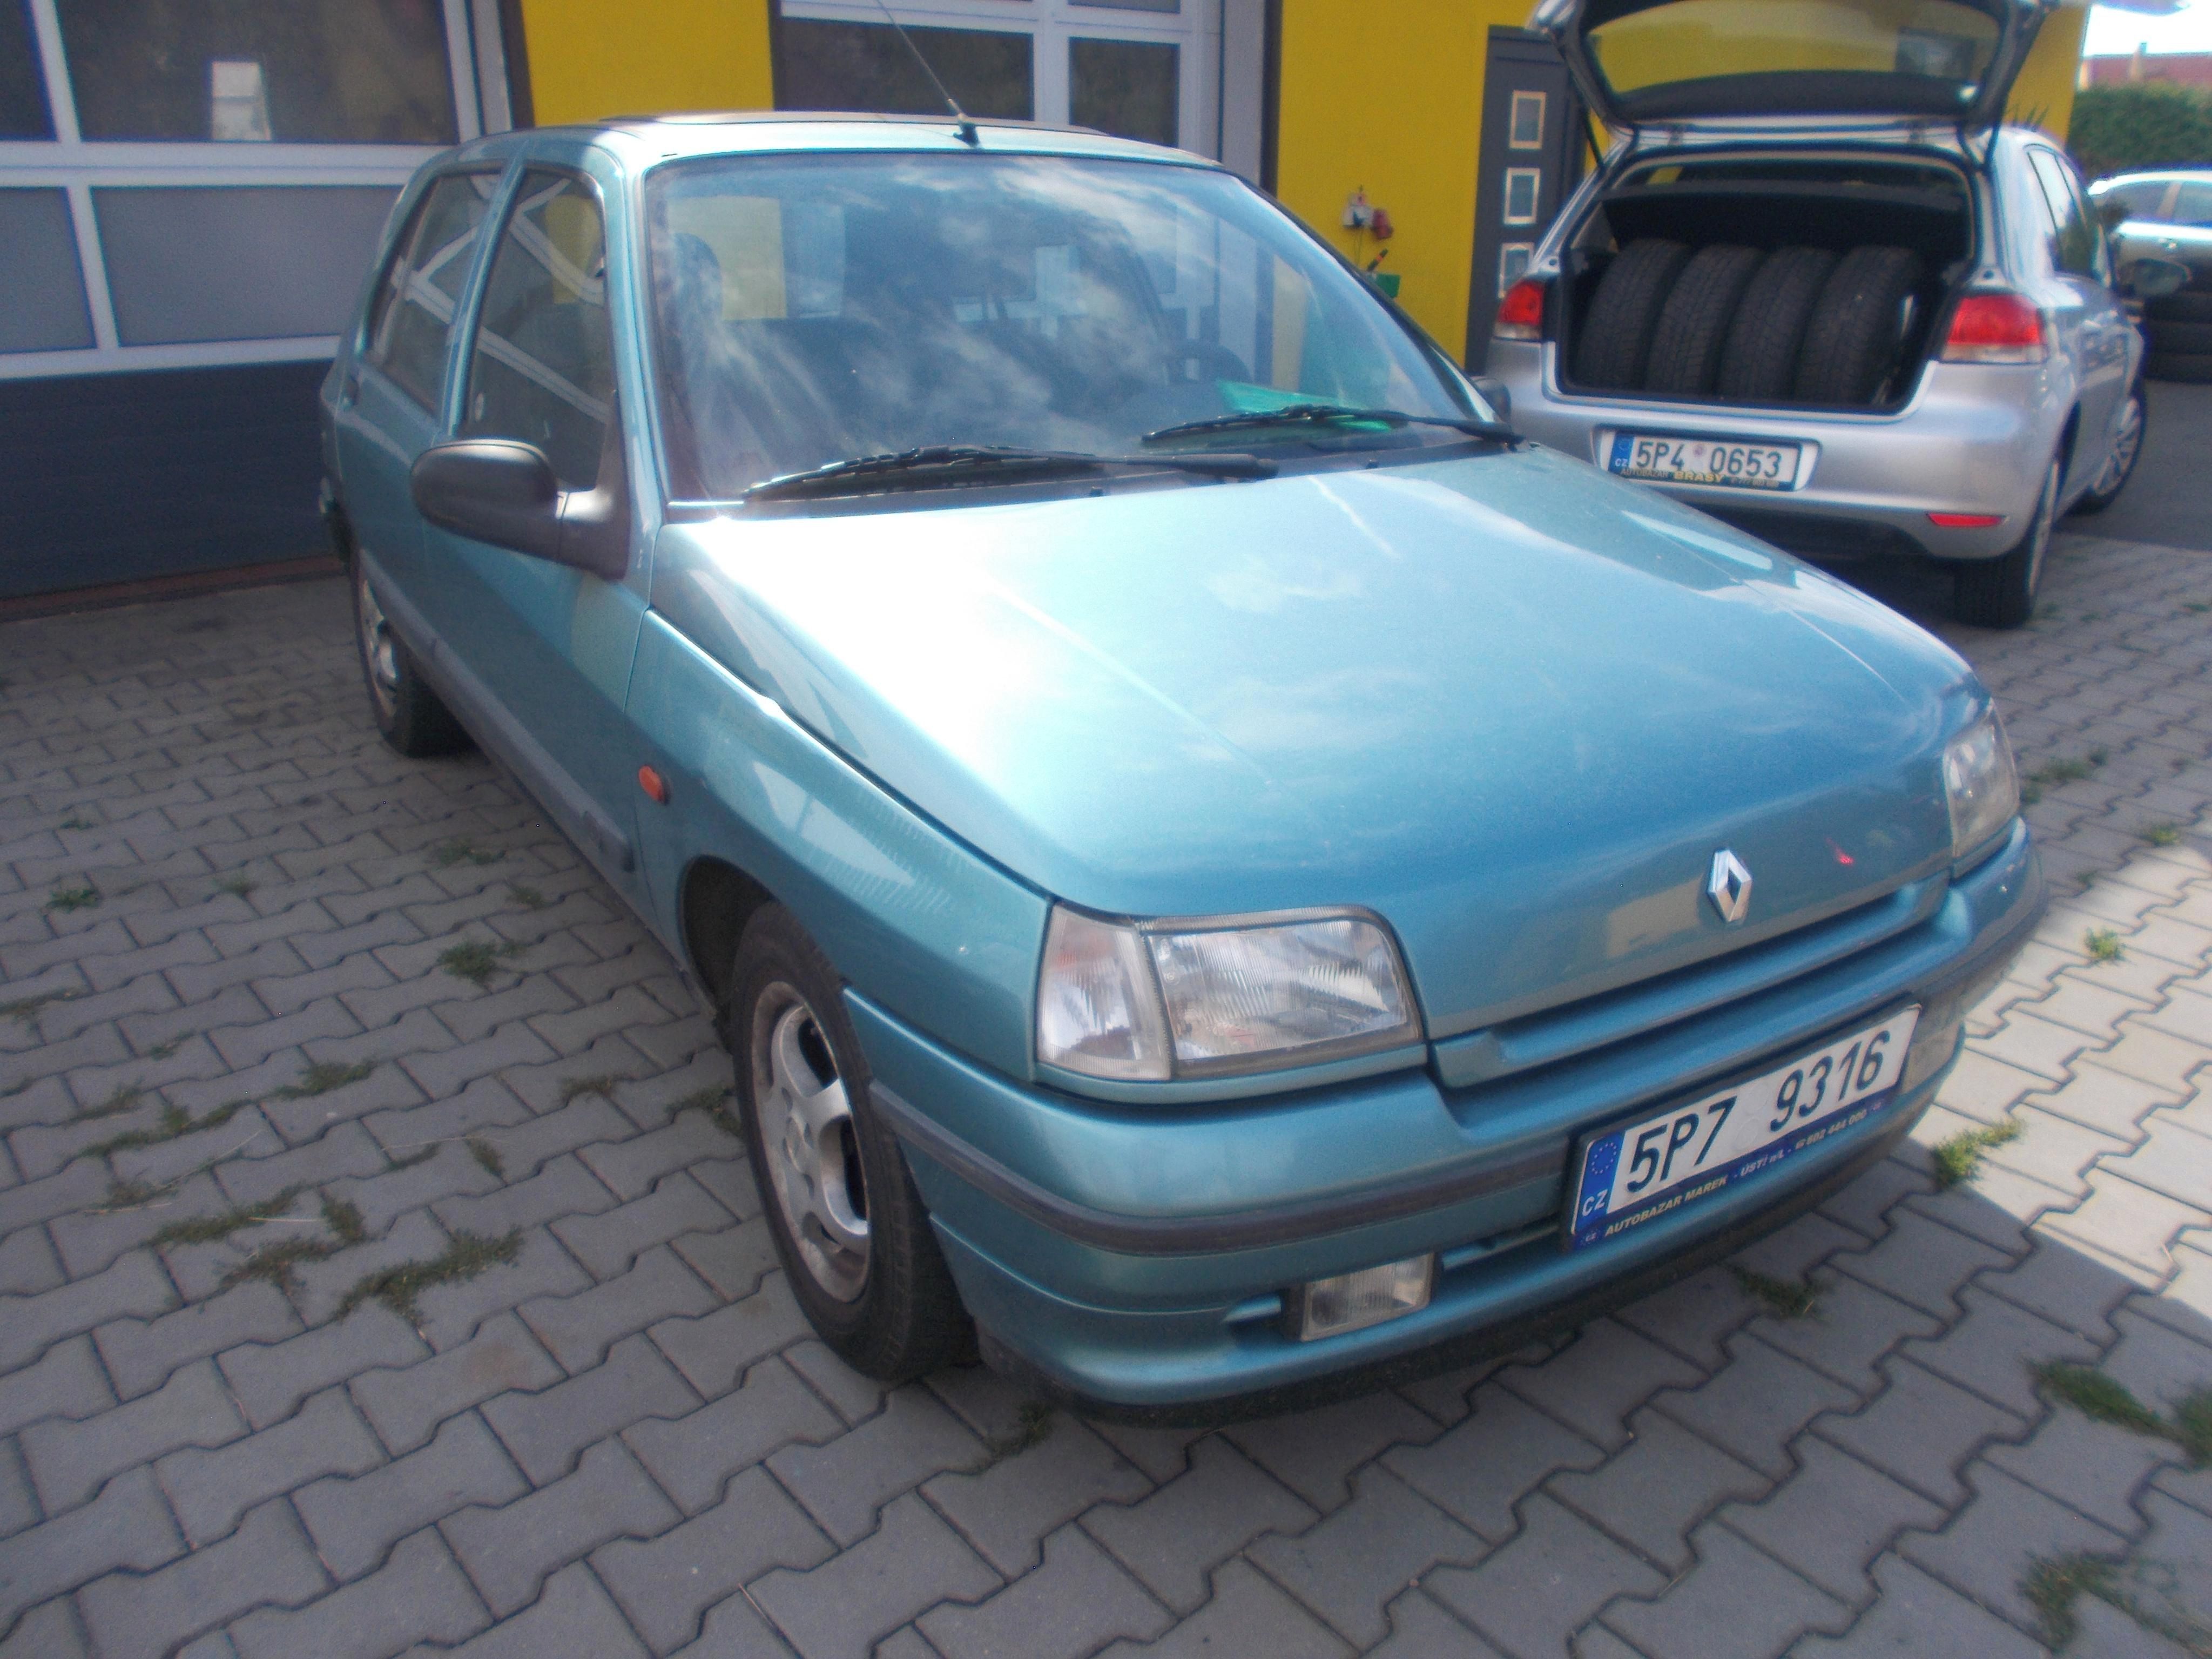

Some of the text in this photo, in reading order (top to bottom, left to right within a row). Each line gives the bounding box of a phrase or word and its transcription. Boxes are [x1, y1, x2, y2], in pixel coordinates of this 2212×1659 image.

[1615, 458, 1628, 467] CZ
[1635, 440, 1782, 478] 5P4 0653
[1627, 1030, 1890, 1193] 5P7 9316
[1582, 1189, 1608, 1217] CZ
[1605, 1195, 1683, 1237] AUTOBAZAR
[1684, 1175, 1728, 1201] MAREK
